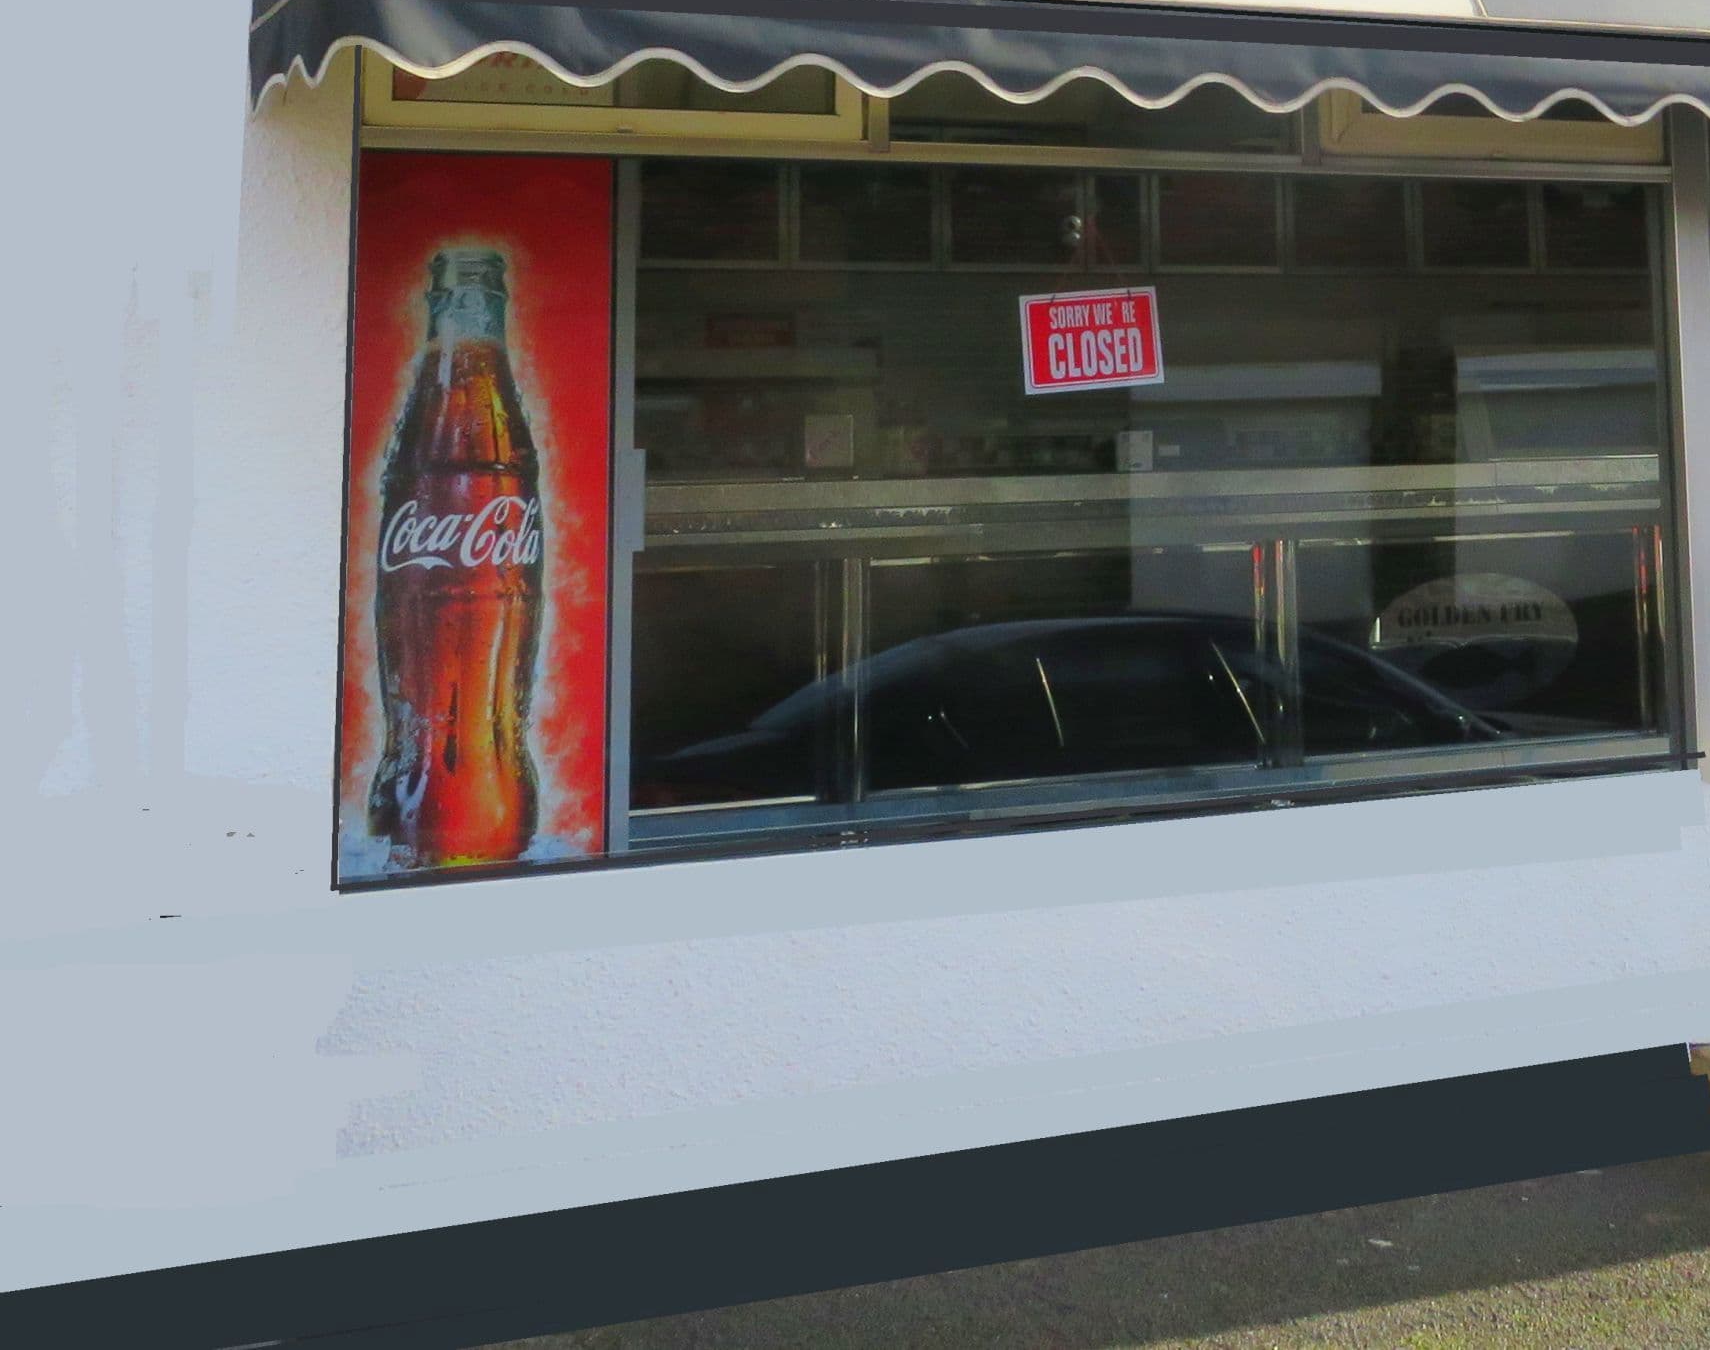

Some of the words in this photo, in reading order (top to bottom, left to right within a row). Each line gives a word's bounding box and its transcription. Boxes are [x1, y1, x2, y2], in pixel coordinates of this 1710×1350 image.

[1049, 304, 1090, 330] SORRY
[1048, 327, 1144, 380] CLOSED
[381, 495, 540, 572] Coca-Cola
[1397, 603, 1491, 627] GOLDEN
[1500, 601, 1542, 623] FRY
